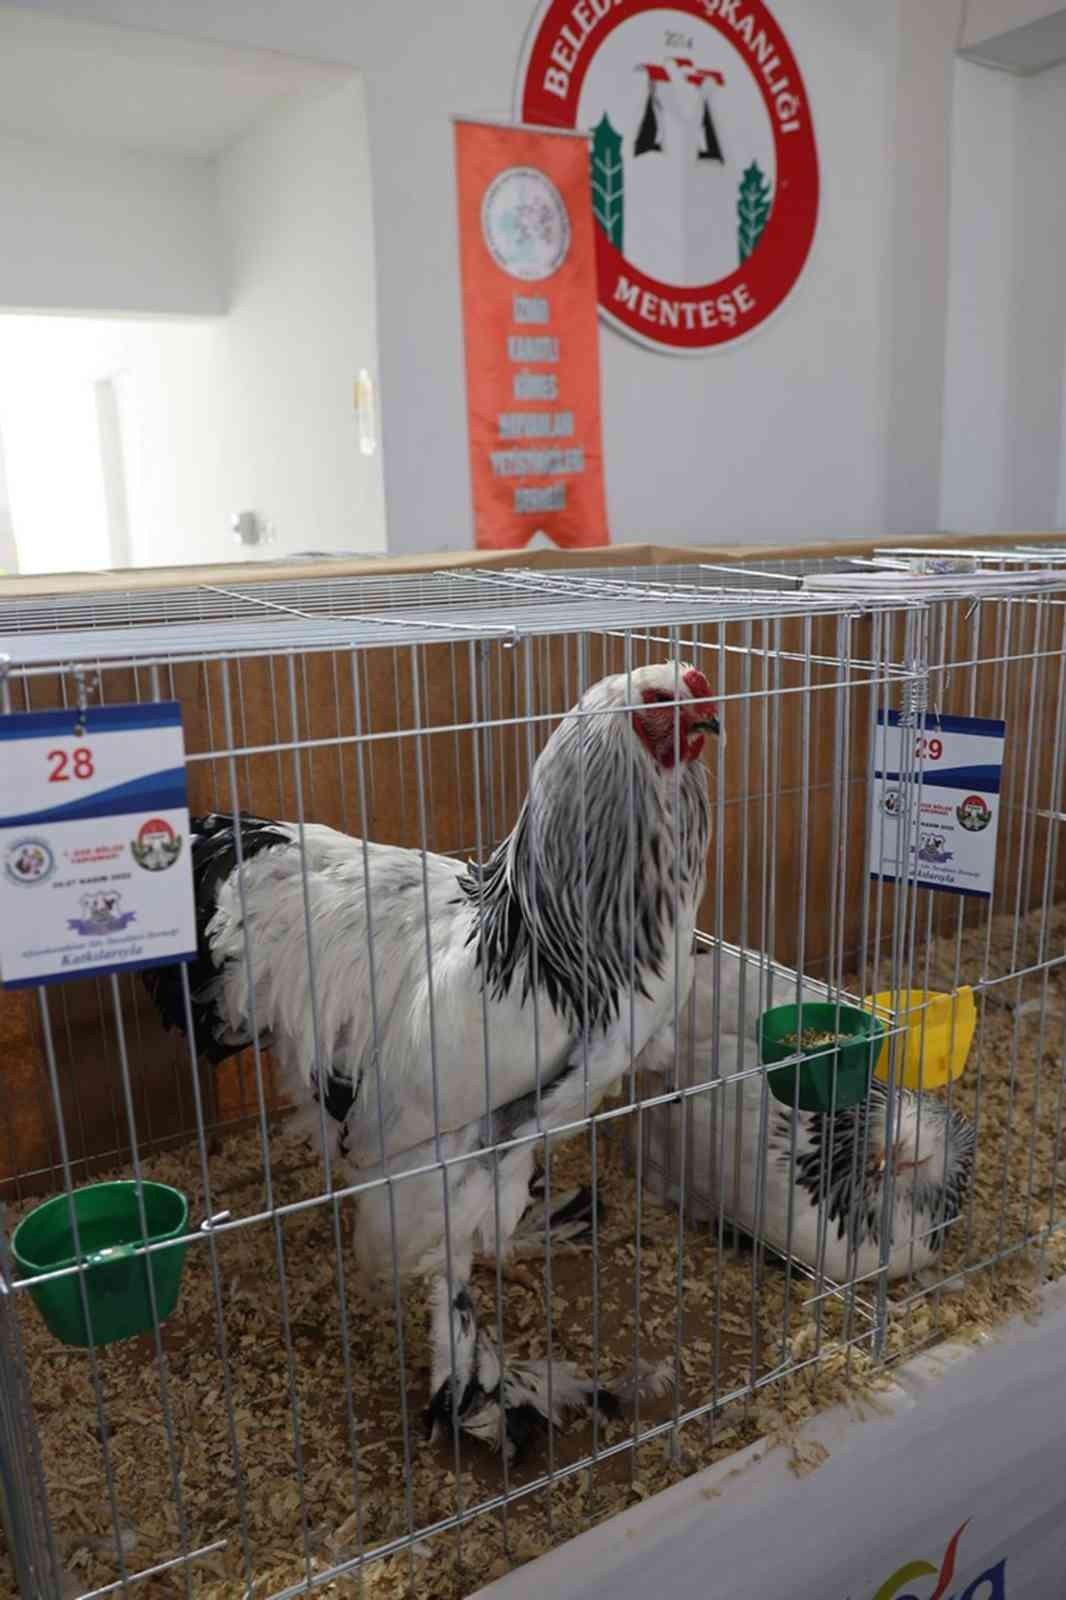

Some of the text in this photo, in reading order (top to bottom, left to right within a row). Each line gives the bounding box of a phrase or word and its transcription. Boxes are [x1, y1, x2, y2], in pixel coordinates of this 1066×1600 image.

[543, 0, 622, 98] BELED
[613, 276, 756, 330] MENTEŞE
[47, 748, 95, 783] 28
[914, 737, 944, 760] 29
